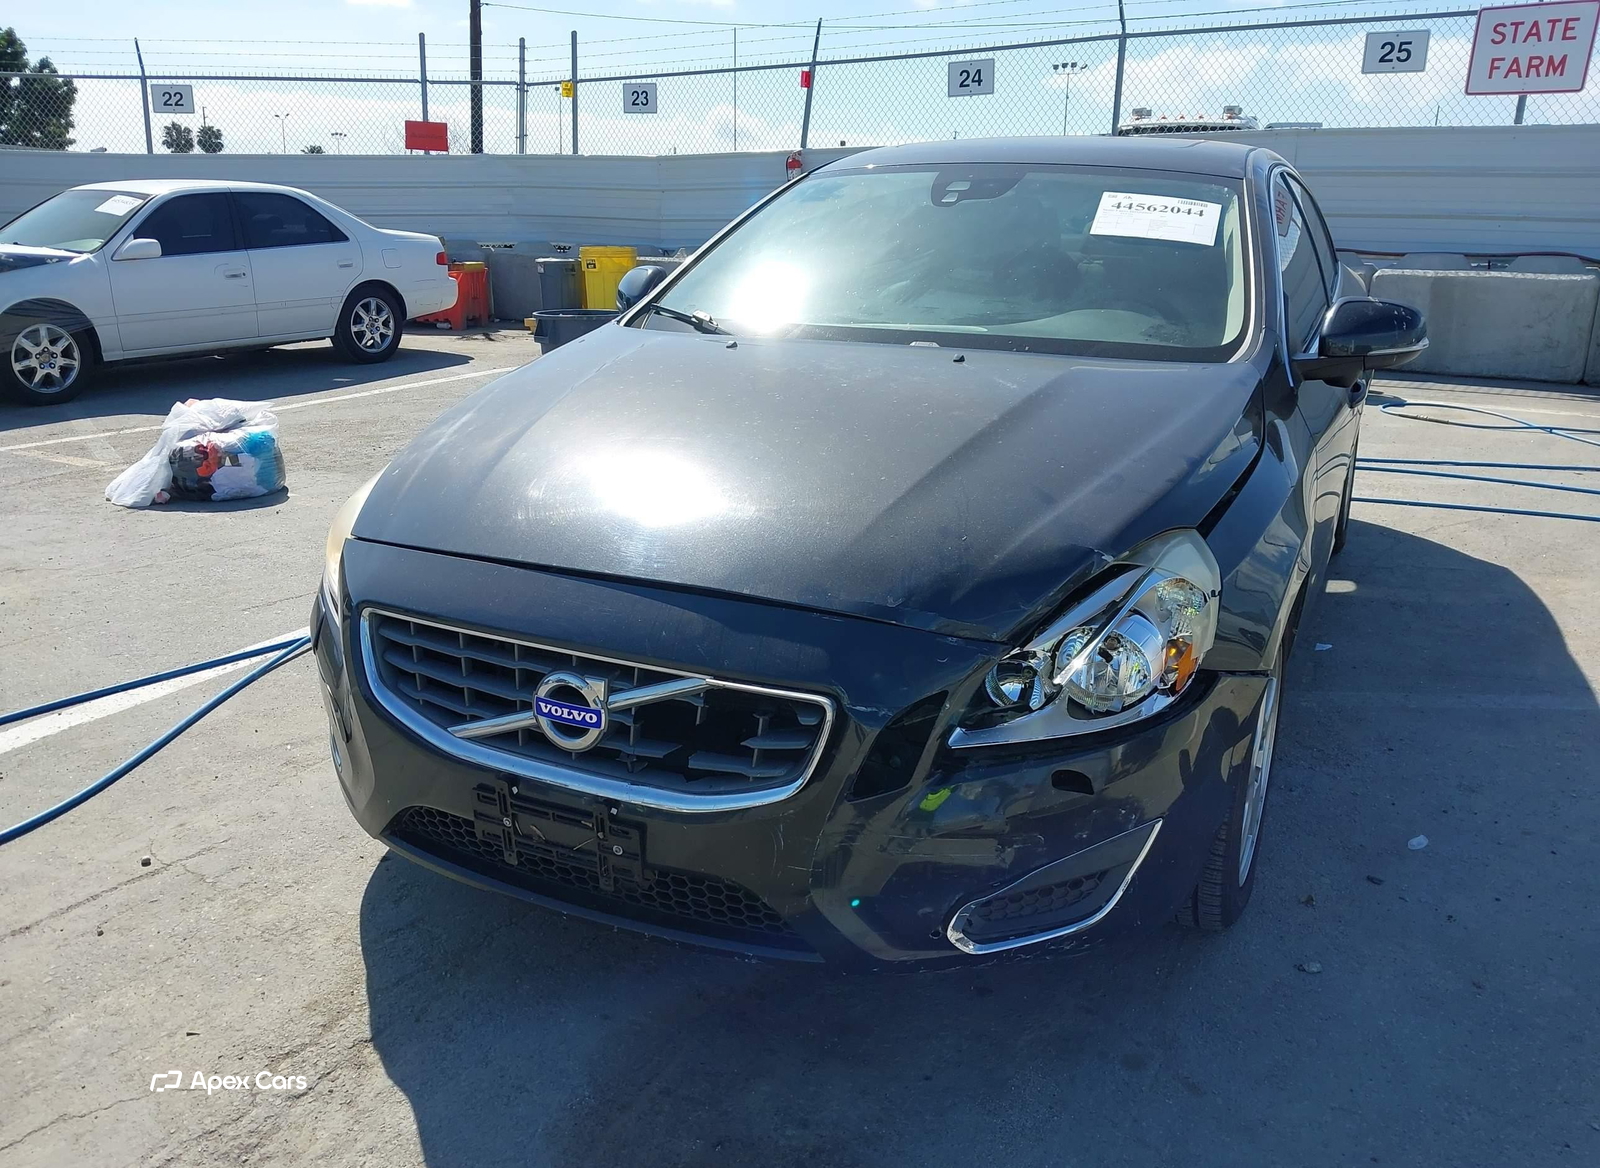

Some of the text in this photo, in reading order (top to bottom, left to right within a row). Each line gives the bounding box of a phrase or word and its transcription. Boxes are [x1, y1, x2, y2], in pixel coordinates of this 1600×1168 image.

[1490, 17, 1581, 45] STATE
[1378, 41, 1413, 63] 25
[1488, 54, 1568, 79] FARM
[958, 68, 983, 88] 24
[162, 91, 185, 107] 22
[631, 90, 649, 106] 23
[1111, 201, 1205, 217] 44562044
[538, 701, 598, 724] VOLVO
